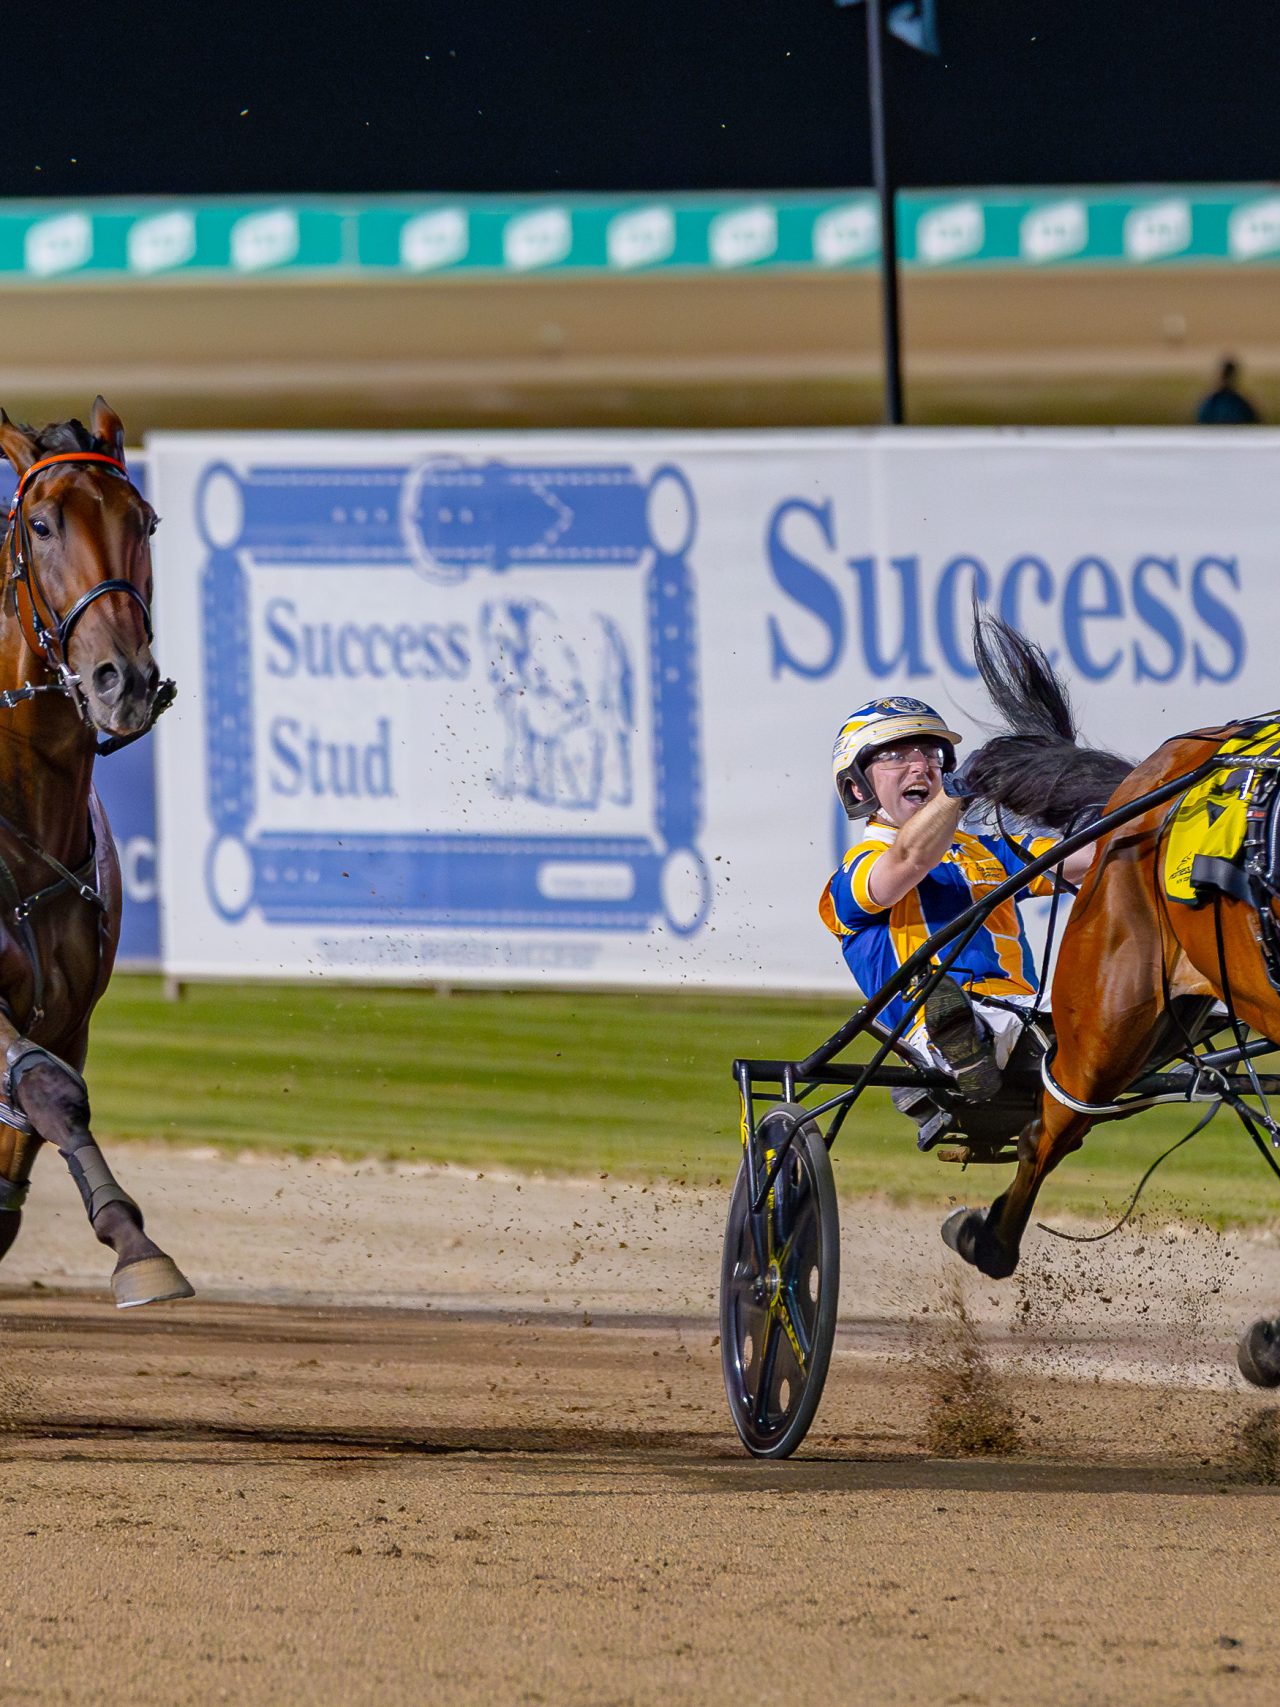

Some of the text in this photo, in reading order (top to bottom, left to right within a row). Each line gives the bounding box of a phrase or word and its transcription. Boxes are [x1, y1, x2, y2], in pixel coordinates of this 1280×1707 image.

[764, 496, 1247, 685] Success
[263, 598, 472, 681] Success
[269, 717, 396, 800] Stud
